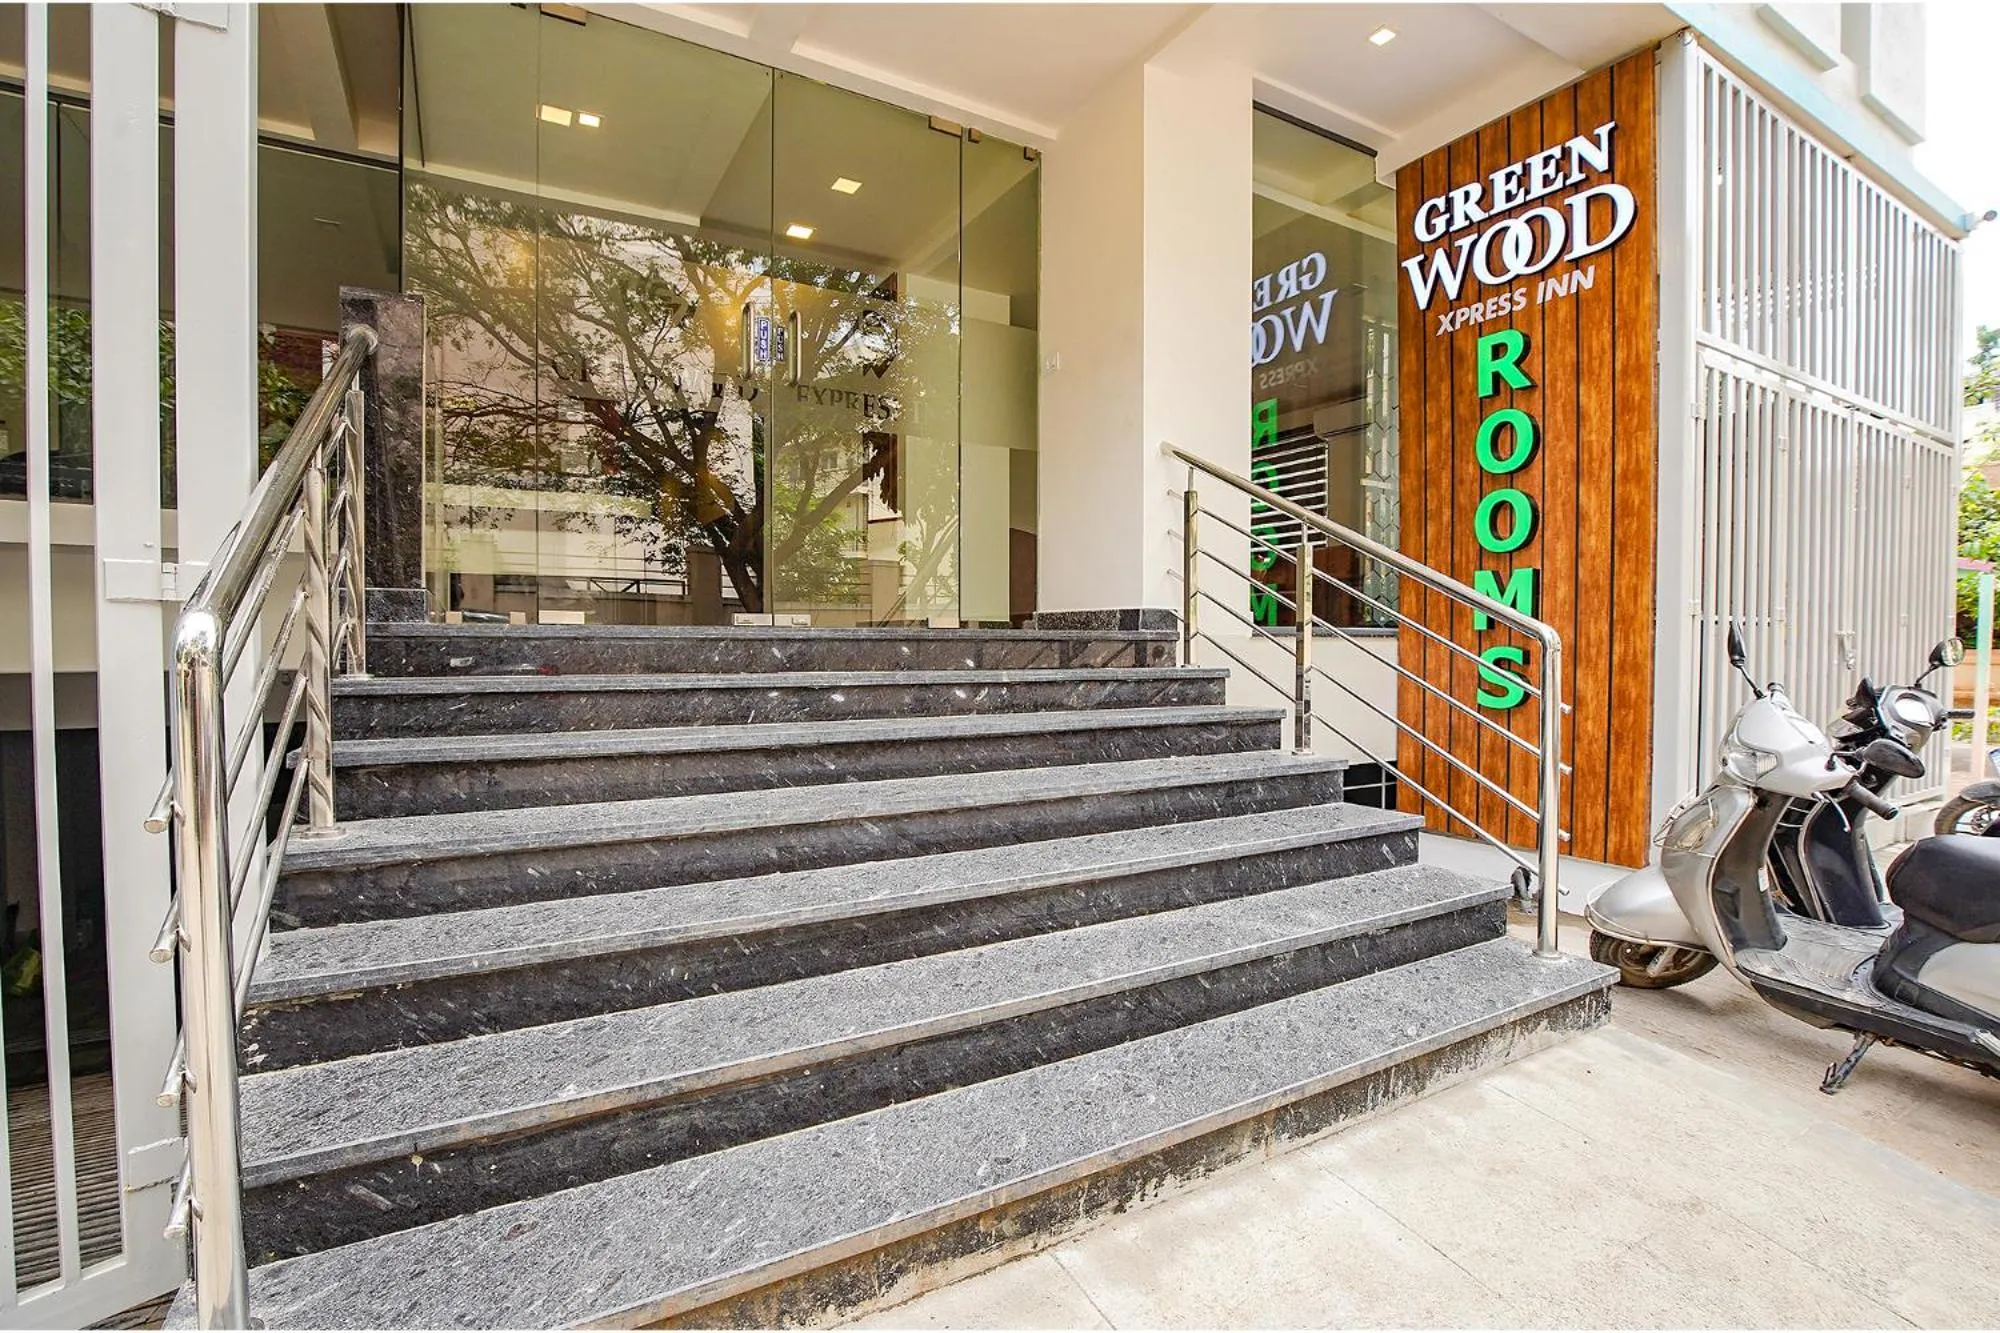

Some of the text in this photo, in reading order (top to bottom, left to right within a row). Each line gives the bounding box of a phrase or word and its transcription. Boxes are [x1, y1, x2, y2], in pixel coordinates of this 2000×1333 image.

[1413, 121, 1616, 243] GREEN
[1401, 183, 1636, 311] WOOD
[760, 319, 768, 360] PUSH
[776, 327, 784, 361] PUSH
[1436, 265, 1595, 336] XPRESS INN
[1473, 328, 1537, 710] ROOMS
